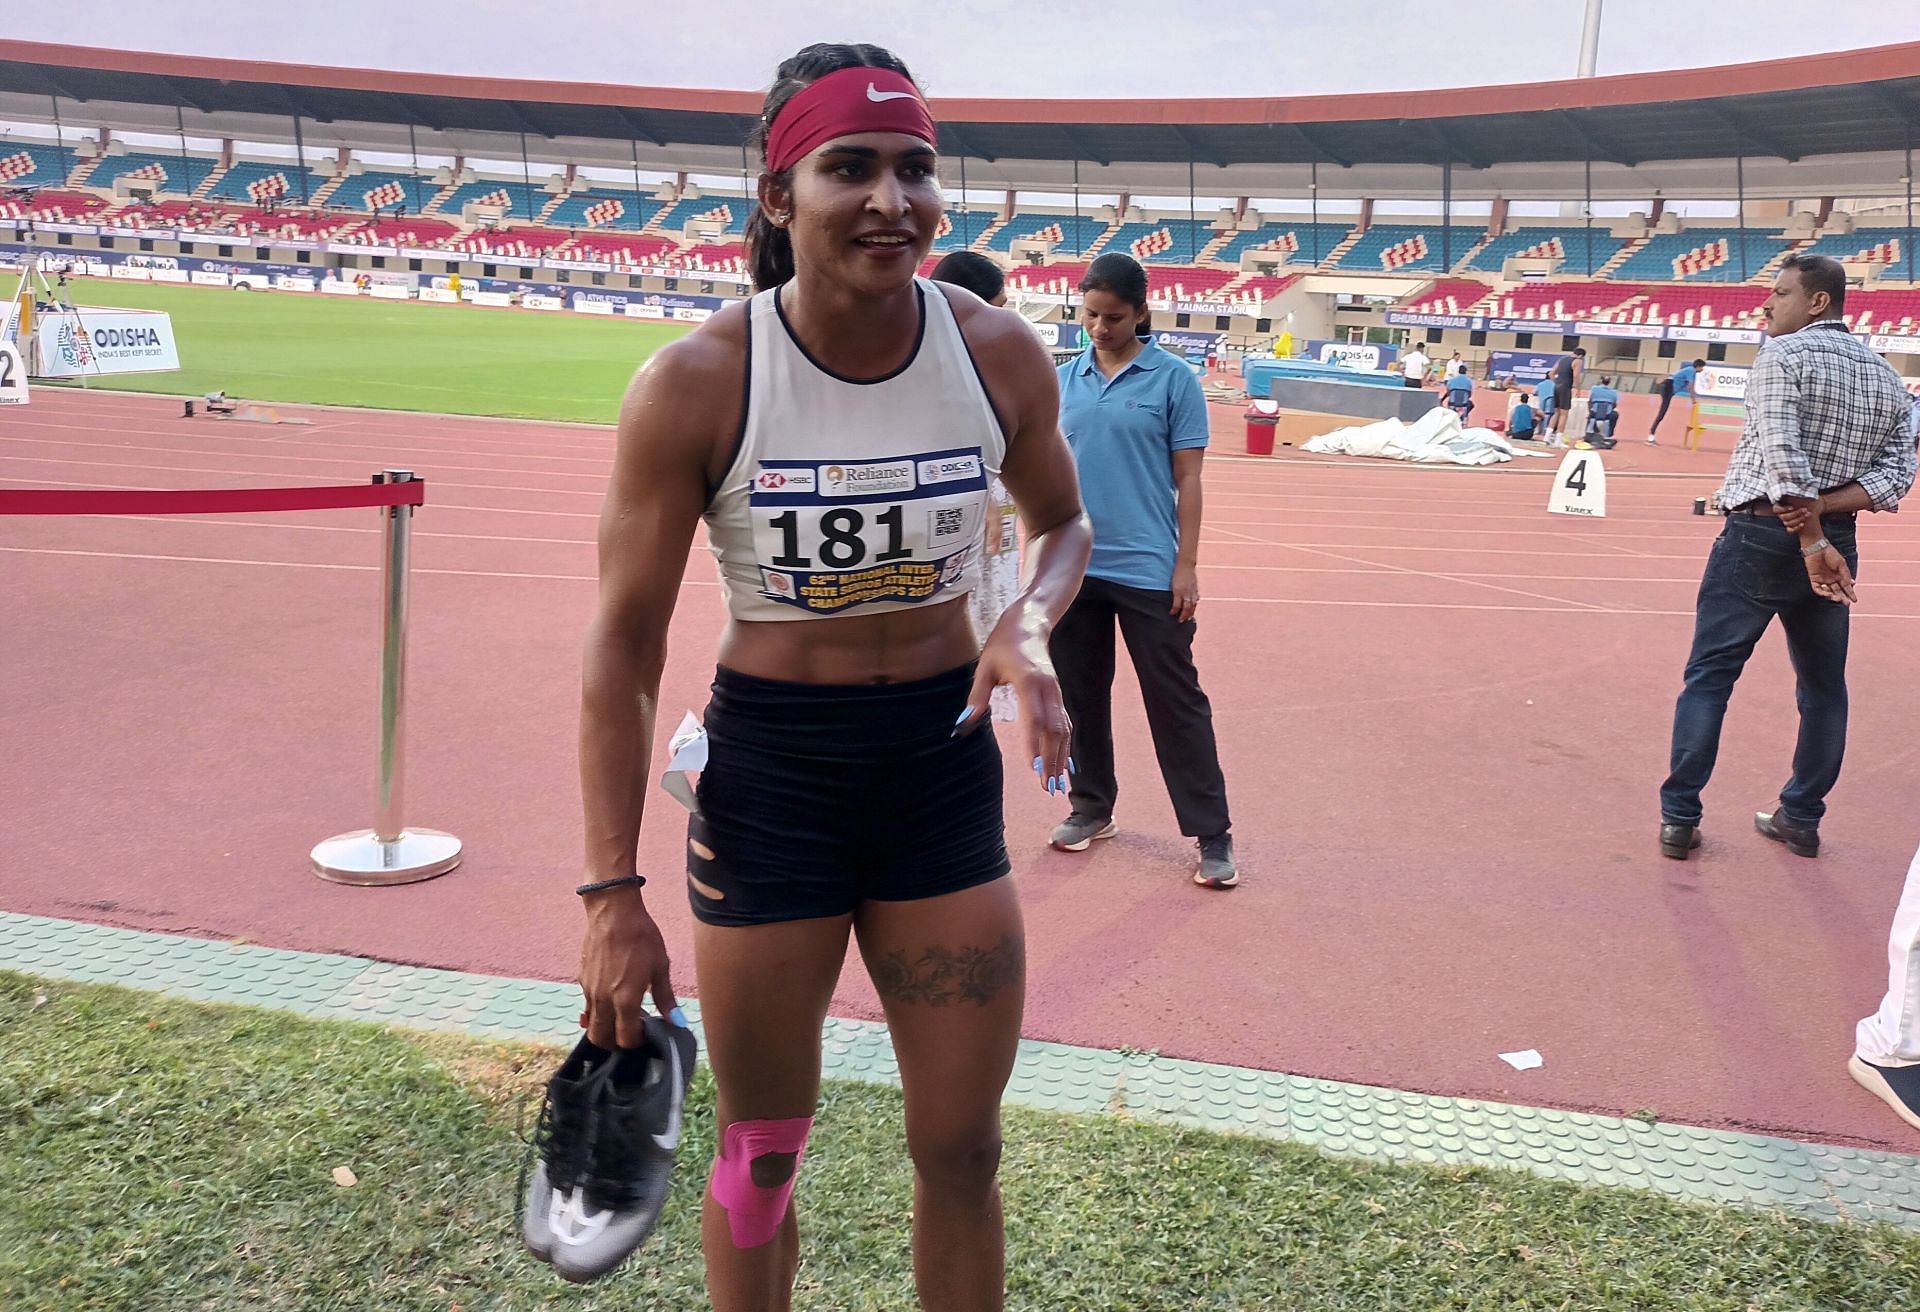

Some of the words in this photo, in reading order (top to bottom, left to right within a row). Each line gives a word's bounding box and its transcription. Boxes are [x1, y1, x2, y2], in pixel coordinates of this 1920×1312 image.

[1176, 302, 1215, 313] KALINGA
[1217, 304, 1248, 315] STADIU
[1389, 313, 1467, 327] BHUBANESWAR
[94, 327, 161, 348] ODISHA
[98, 351, 119, 359] INDIA'S
[119, 350, 131, 358] BEST
[132, 349, 144, 358] KEPT
[0, 350, 16, 387] 2
[846, 465, 909, 482] Reliance
[1565, 460, 1587, 496] 4
[847, 479, 909, 493] Foundation
[769, 505, 912, 569] 181
[839, 565, 898, 584] NATIONAL
[899, 564, 936, 574] INTER
[799, 586, 838, 597] STATE
[840, 578, 882, 595] SENIOR
